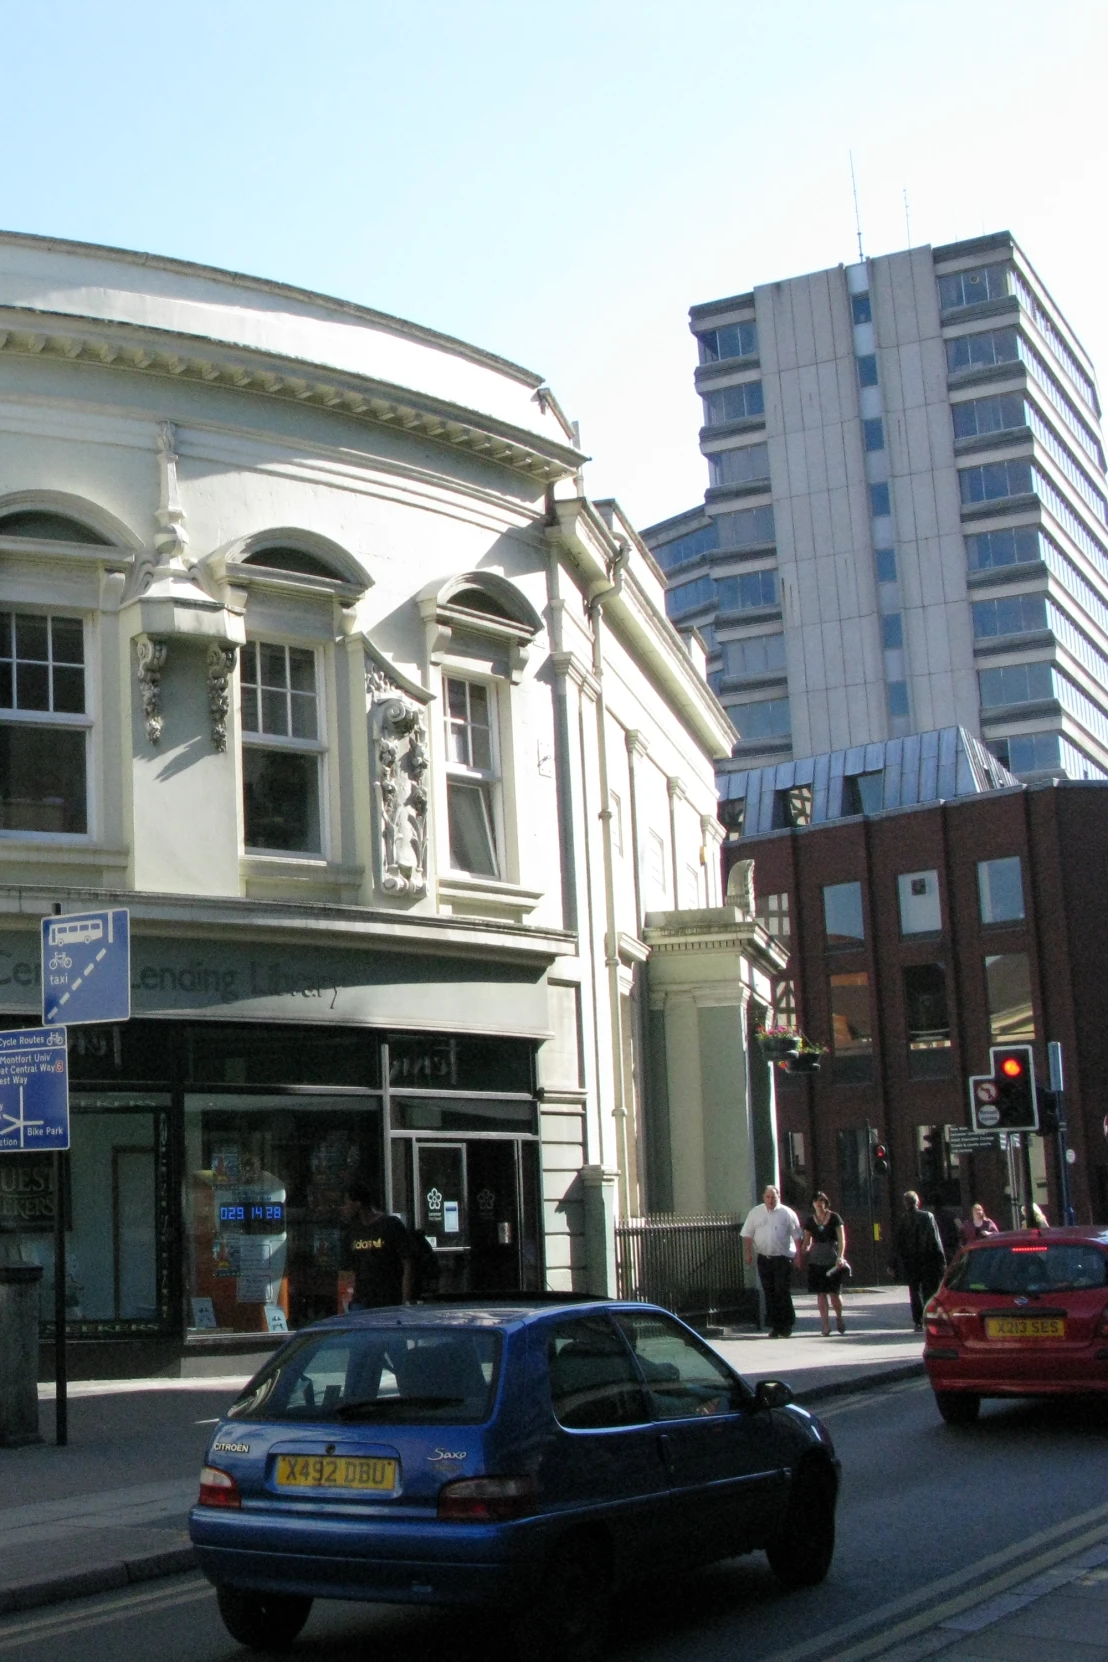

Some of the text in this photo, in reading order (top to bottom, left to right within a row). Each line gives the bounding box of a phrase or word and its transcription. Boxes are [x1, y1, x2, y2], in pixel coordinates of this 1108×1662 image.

[50, 973, 68, 985] taxi
[131, 960, 239, 1004] ending
[19, 1035, 45, 1045] Routes
[0, 1055, 32, 1065] Montfort
[11, 1064, 38, 1075] Central
[40, 1063, 55, 1073] Way
[12, 1075, 28, 1085] Way
[27, 1126, 64, 1136] Bike Park
[220, 1206, 282, 1220] 029 14 28
[1031, 1320, 1059, 1334] SES
[427, 1447, 467, 1461] Saxo
[285, 1458, 387, 1485] X492 DBU
